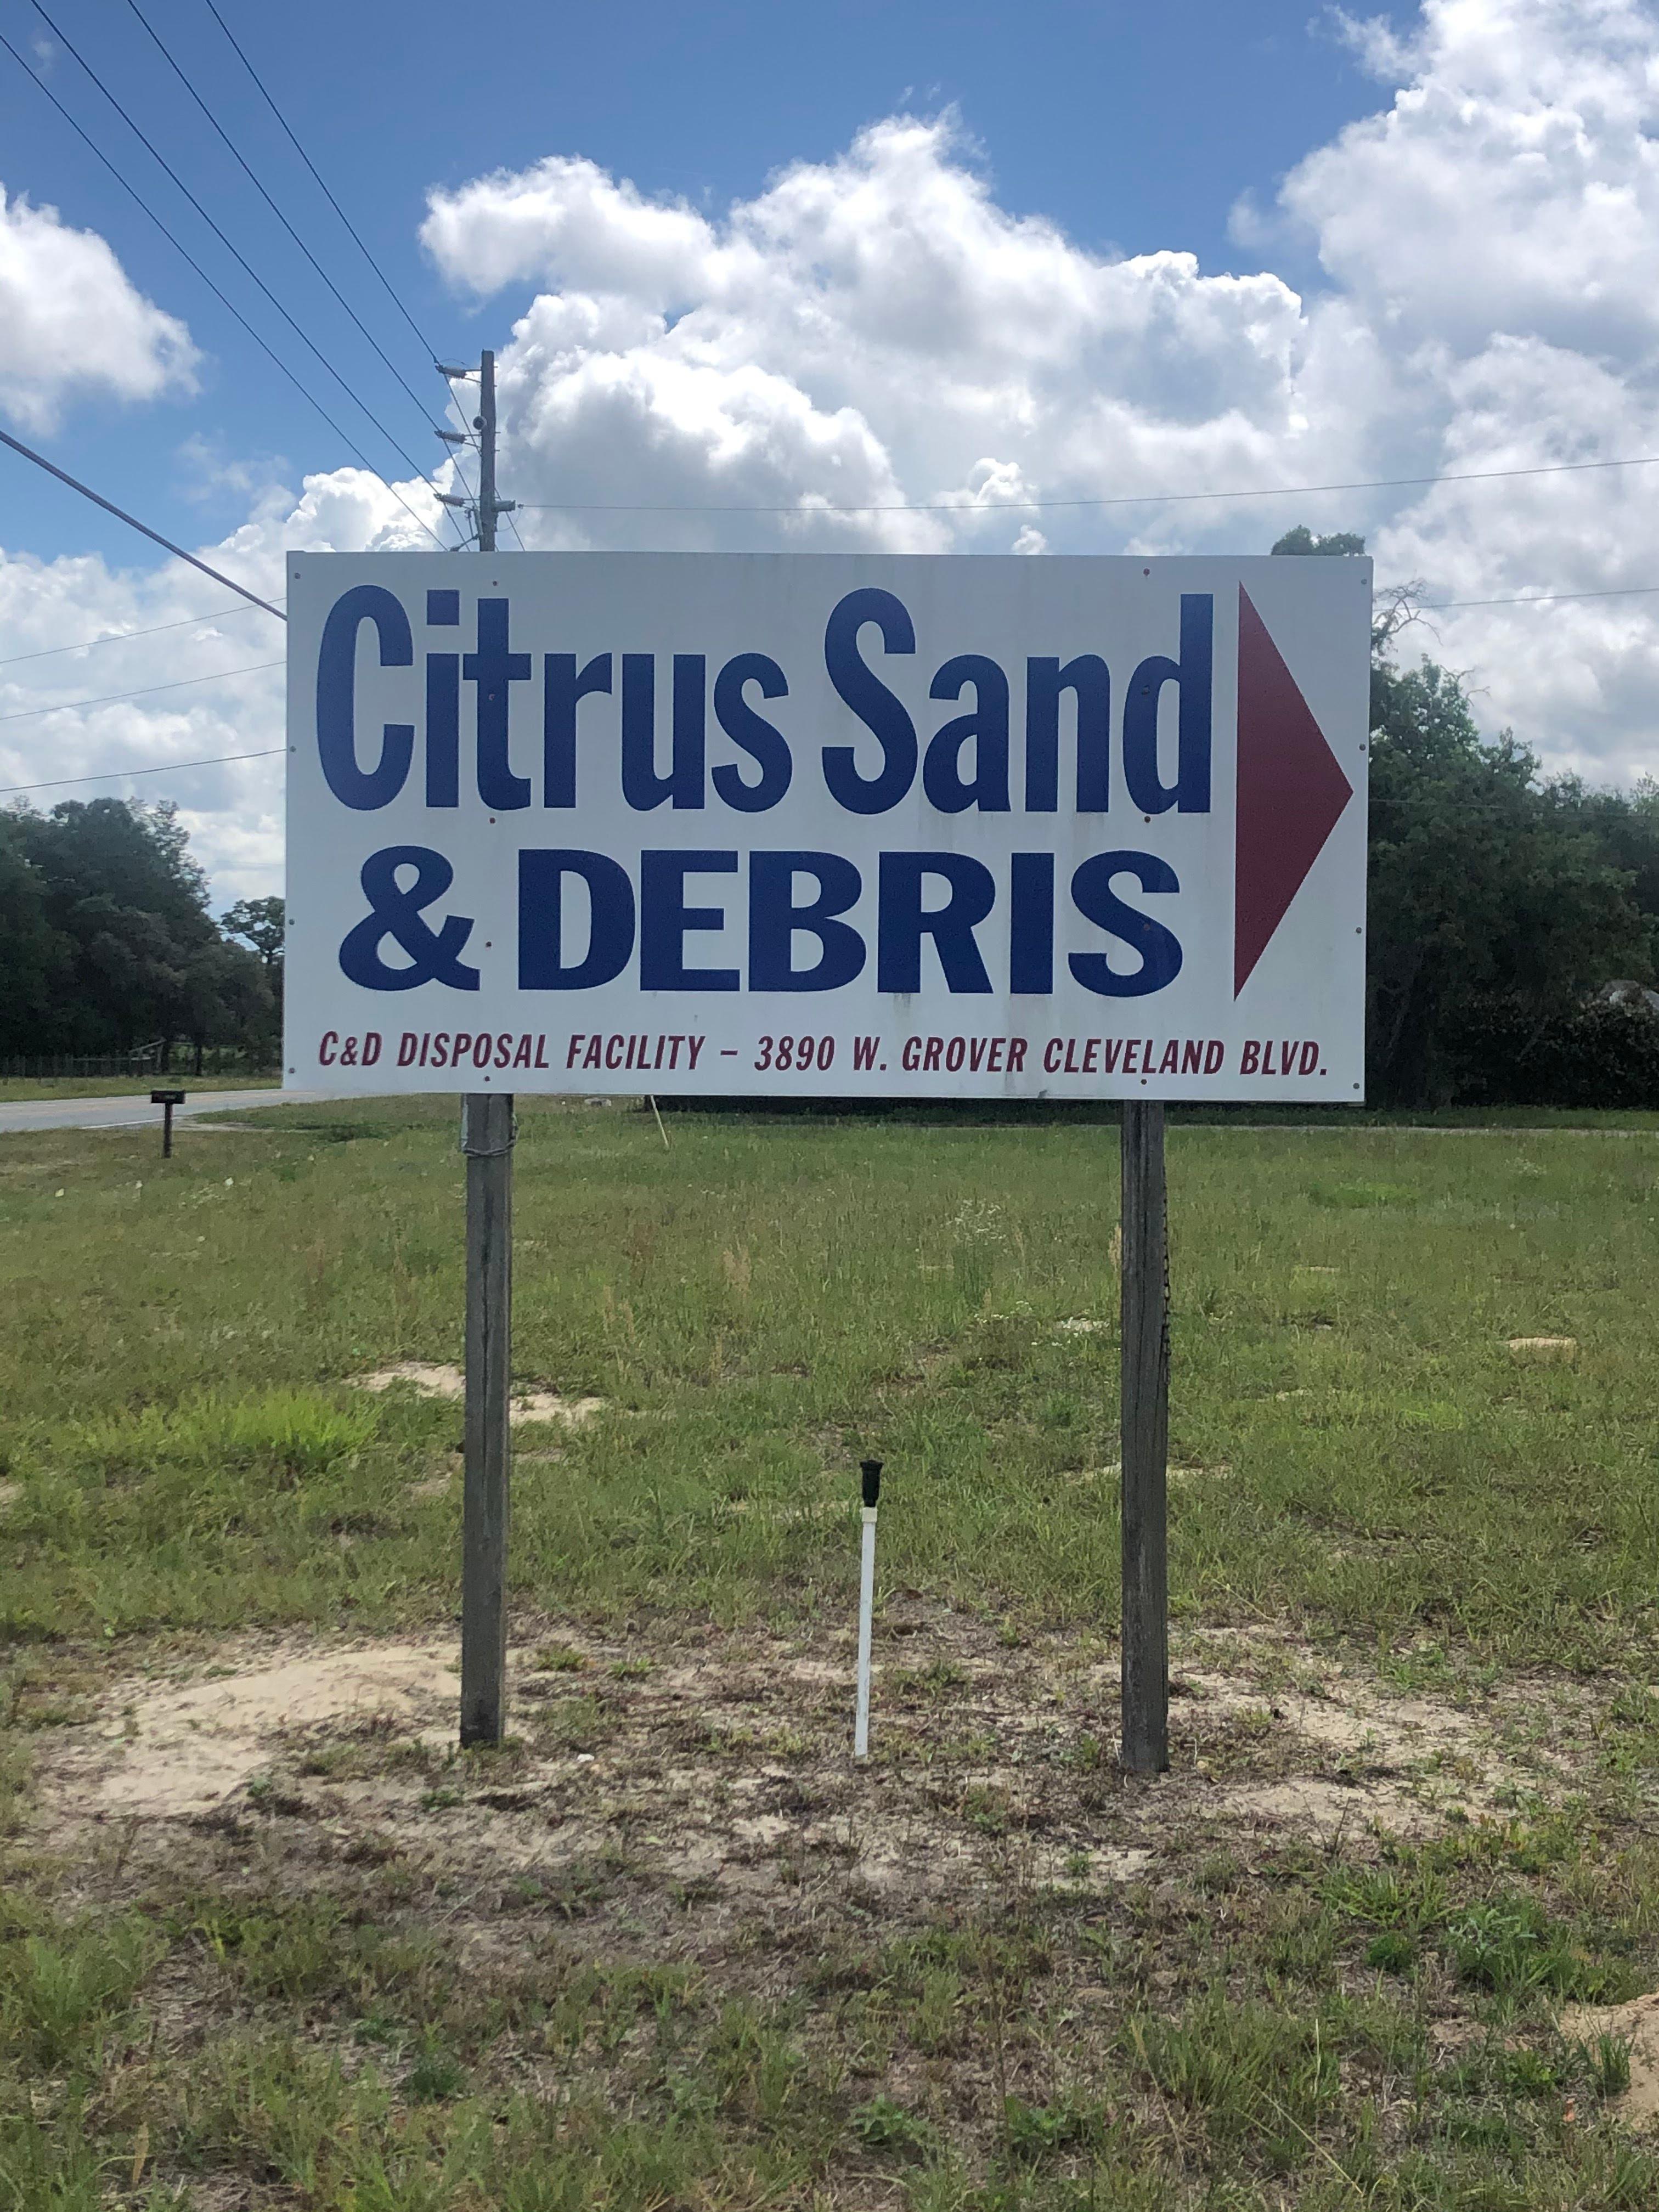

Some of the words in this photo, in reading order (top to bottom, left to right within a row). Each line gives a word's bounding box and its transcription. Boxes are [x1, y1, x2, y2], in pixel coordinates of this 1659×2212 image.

[317, 585, 792, 812] Citrus
[822, 588, 1213, 814] Sand
[338, 845, 481, 991] &
[518, 849, 1183, 997] DEBRIS
[319, 1031, 381, 1066] C&D
[397, 1032, 549, 1068] DISPOSAL
[566, 1034, 706, 1070] FACILITY
[754, 1036, 834, 1071] 3890
[854, 1036, 887, 1071] W.
[902, 1036, 1028, 1073] GROVER
[1043, 1038, 1224, 1074] CLEVELAND
[1240, 1041, 1327, 1075] BLVD.
